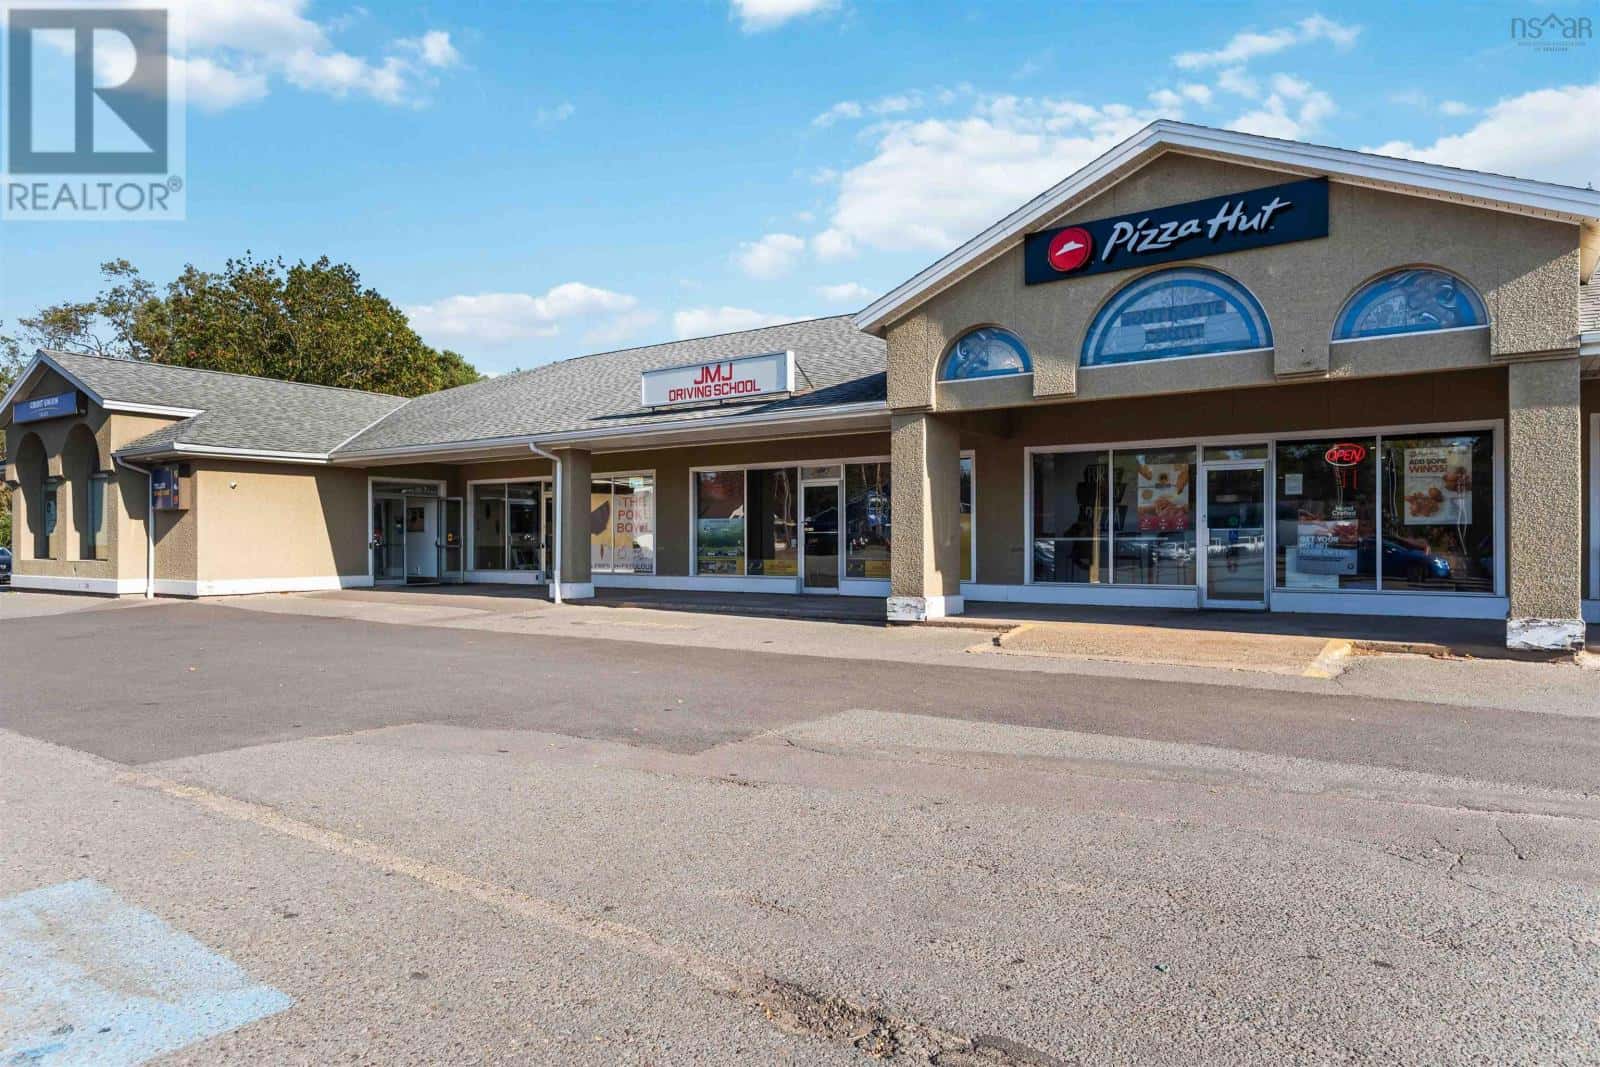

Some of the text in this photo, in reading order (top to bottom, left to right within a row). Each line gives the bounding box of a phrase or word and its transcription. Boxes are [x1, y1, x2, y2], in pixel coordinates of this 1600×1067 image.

[1102, 197, 1291, 261] Pizza Hut
[694, 362, 733, 385] JMJ
[668, 379, 761, 401] DRIVING SCHOOL
[1327, 448, 1364, 462] OPEN
